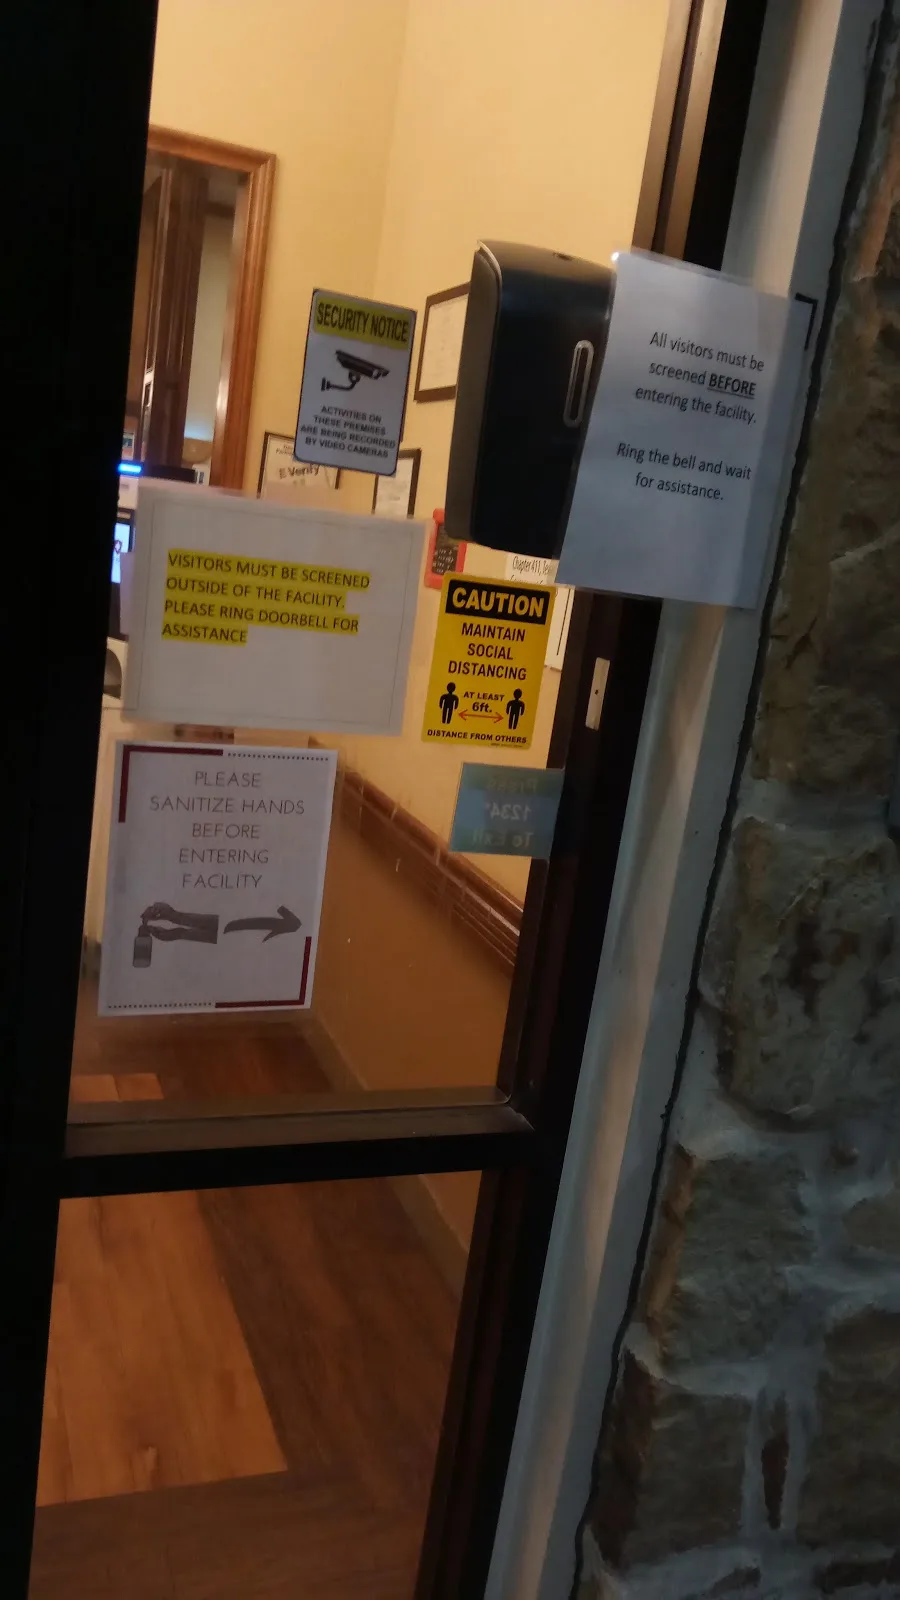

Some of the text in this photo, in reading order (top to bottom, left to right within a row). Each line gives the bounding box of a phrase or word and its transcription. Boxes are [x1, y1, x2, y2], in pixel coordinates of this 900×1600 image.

[316, 302, 409, 342] SECURITY NOTICE
[650, 331, 765, 372] All visitors must be
[649, 362, 756, 397] screened BEFORE
[321, 405, 382, 424] ACTIVITIES ON
[635, 387, 757, 425] entering the facility.
[314, 416, 386, 436] THESE PREMISES
[300, 426, 396, 449] ARE BEING RECORDED
[305, 436, 389, 458] BY VIDEO CAMERAS
[616, 442, 752, 480] Ring the bell and wait
[635, 472, 724, 502] for assistance.
[168, 552, 371, 589] VISITORS MUST BE SCREENED
[166, 577, 345, 610] OUTSIDE OF THE FACILITY.
[452, 587, 545, 618] CAUTION
[164, 600, 360, 632] PLEASE RING DOORBELL FOR
[162, 624, 248, 644] ASSISTANCE
[461, 622, 526, 642] MAINTAIN
[467, 642, 514, 660] SOCIAL
[448, 660, 527, 681] DISTANCING
[464, 691, 506, 702] AT LEAST
[472, 701, 493, 713] 6ft.
[427, 729, 528, 744] DISTANCE FROM OTHERS
[194, 770, 262, 788] PLEASE
[150, 796, 306, 816] SANITIZE HANDS
[192, 823, 260, 840] BEFORE
[178, 848, 270, 865] ENTERING
[182, 873, 263, 889] FACILITY
